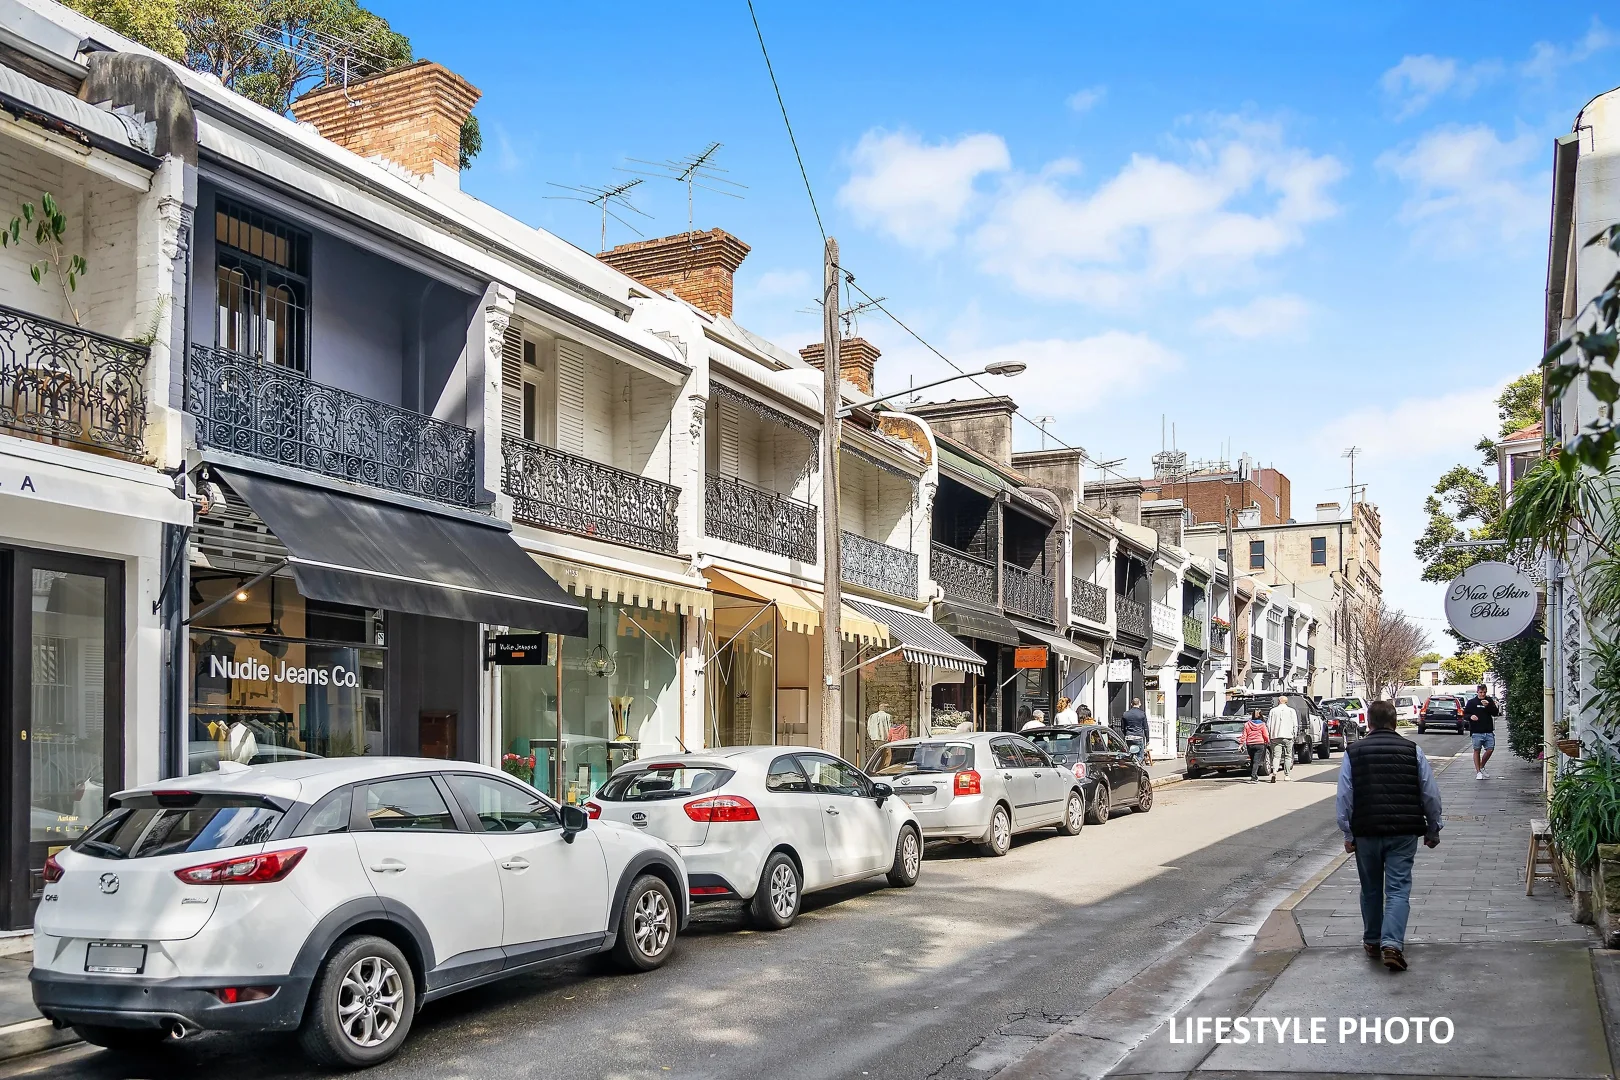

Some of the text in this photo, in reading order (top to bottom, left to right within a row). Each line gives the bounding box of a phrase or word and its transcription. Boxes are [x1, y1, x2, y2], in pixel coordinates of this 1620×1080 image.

[1451, 582, 1531, 602] Nua Skin
[1469, 602, 1510, 619] Bliss
[210, 654, 360, 688] Nudie Jeans Co.
